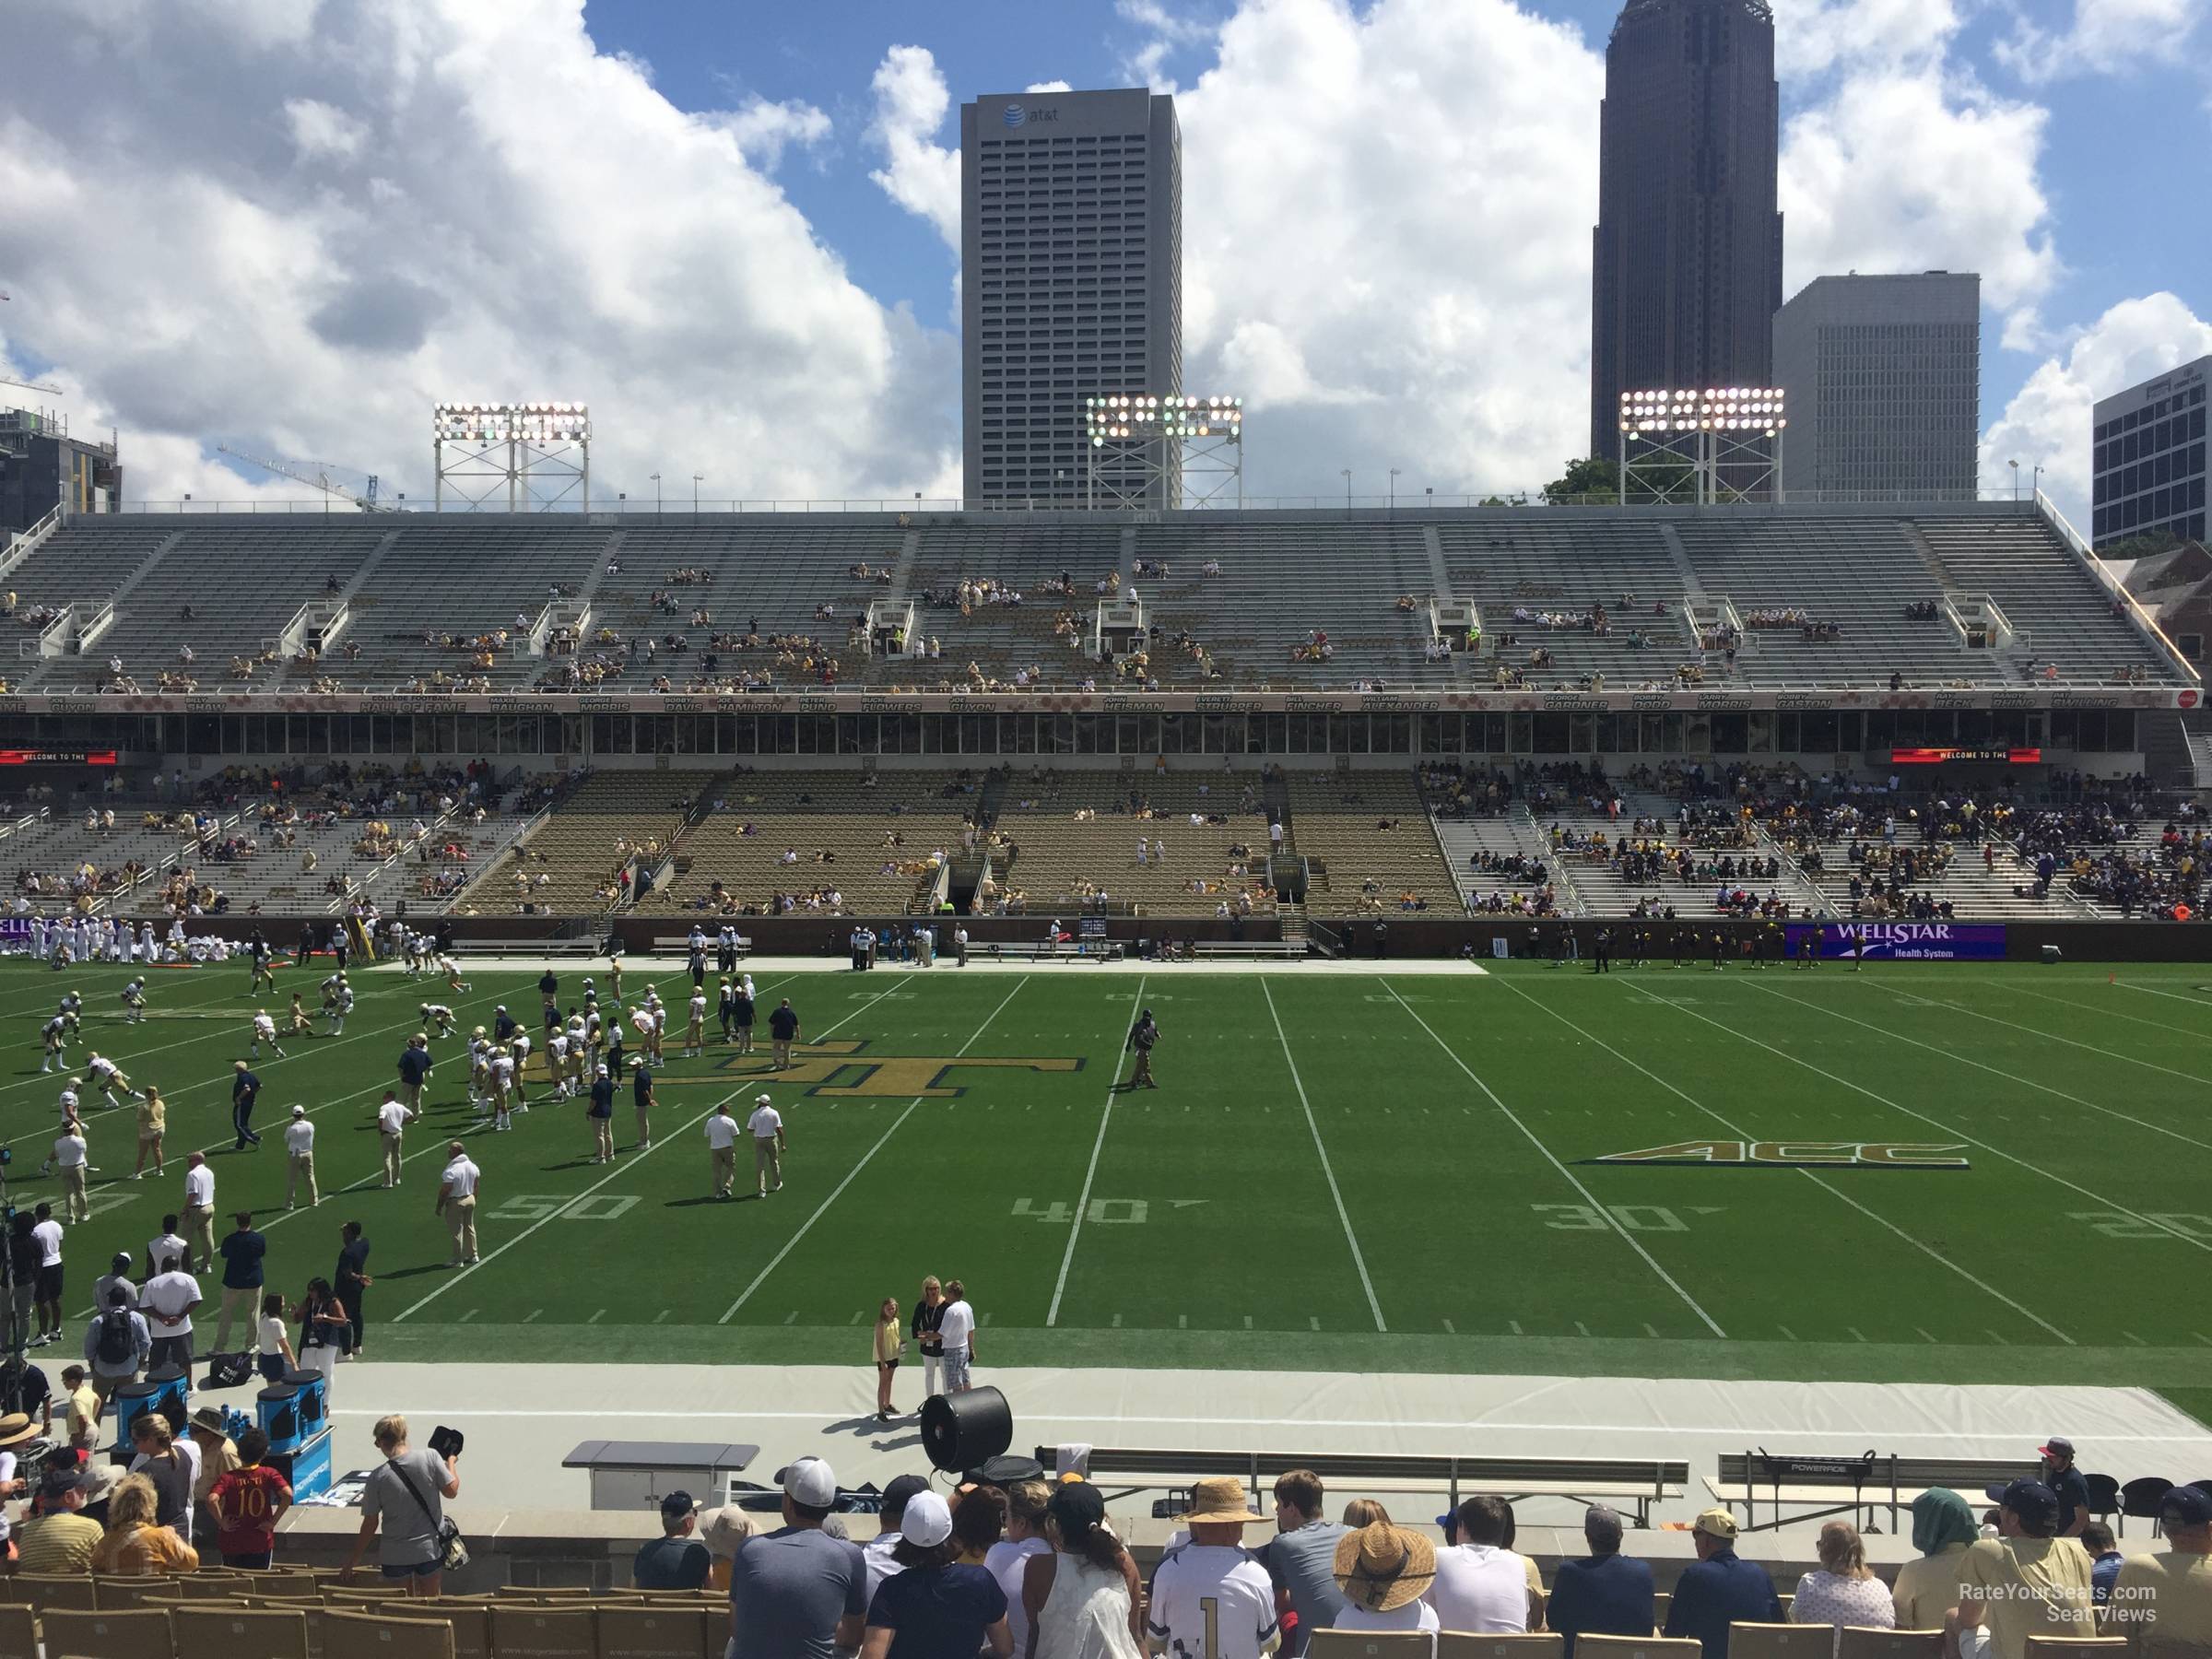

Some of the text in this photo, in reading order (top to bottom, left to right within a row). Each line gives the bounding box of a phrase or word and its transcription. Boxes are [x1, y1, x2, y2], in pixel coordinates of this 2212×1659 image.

[1030, 108, 1058, 122] at&t
[50, 703, 95, 712] GUYON
[186, 703, 226, 712] SHAW
[360, 701, 465, 712] HALL OF FAME
[490, 703, 553, 712] BAUGHAN
[580, 703, 629, 712] MORRIS
[664, 703, 703, 712] DAVIS
[717, 703, 782, 712] HAMILTON
[862, 703, 921, 712] FLOWERS
[950, 703, 995, 712] GUYON
[1104, 702, 1164, 712] HEISMAN
[1195, 702, 1263, 712] STRUPPER
[1285, 702, 1342, 712] FINCHER
[1359, 701, 1440, 711] ALEXANDER
[1544, 700, 1608, 710] GARDNER
[1631, 700, 1671, 710] DODD
[1698, 700, 1751, 710] MORRIS
[1775, 700, 1833, 709] GASTON
[1936, 700, 1973, 709] BECK
[1991, 700, 2036, 709] RHINO
[2051, 699, 2118, 709] SWILLING
[1837, 924, 1950, 943] WELLSTAR
[1895, 948, 1954, 959] Health System
[1578, 1139, 1971, 1169] ACC
[486, 1194, 642, 1220] 50
[1011, 1198, 1148, 1224] 40
[1530, 1203, 1691, 1231] 30
[238, 1488, 266, 1517] 10
[1201, 1597, 1218, 1659] 1
